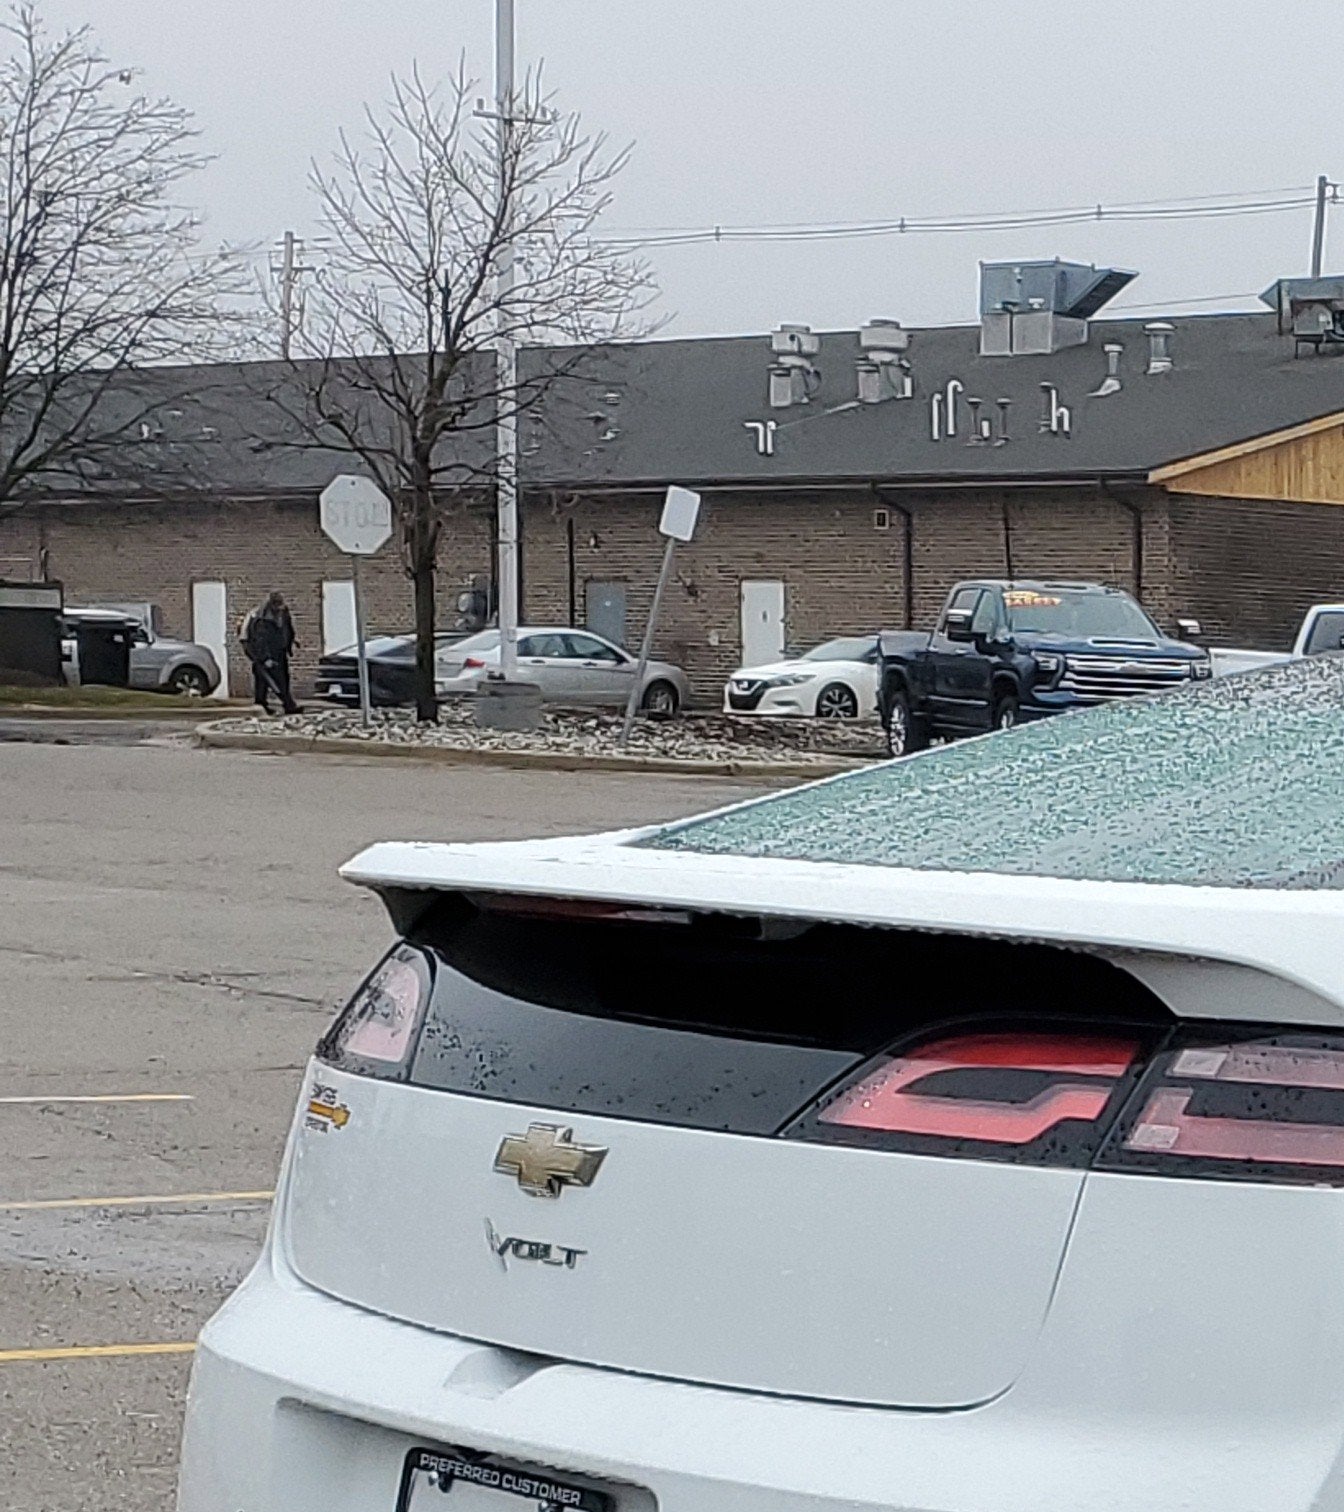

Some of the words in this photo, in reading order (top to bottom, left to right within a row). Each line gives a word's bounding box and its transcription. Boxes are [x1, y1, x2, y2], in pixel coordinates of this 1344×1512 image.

[484, 1216, 588, 1273] VOLT
[419, 1452, 500, 1486] PREFERRED
[501, 1473, 582, 1506] CUSTOMER
